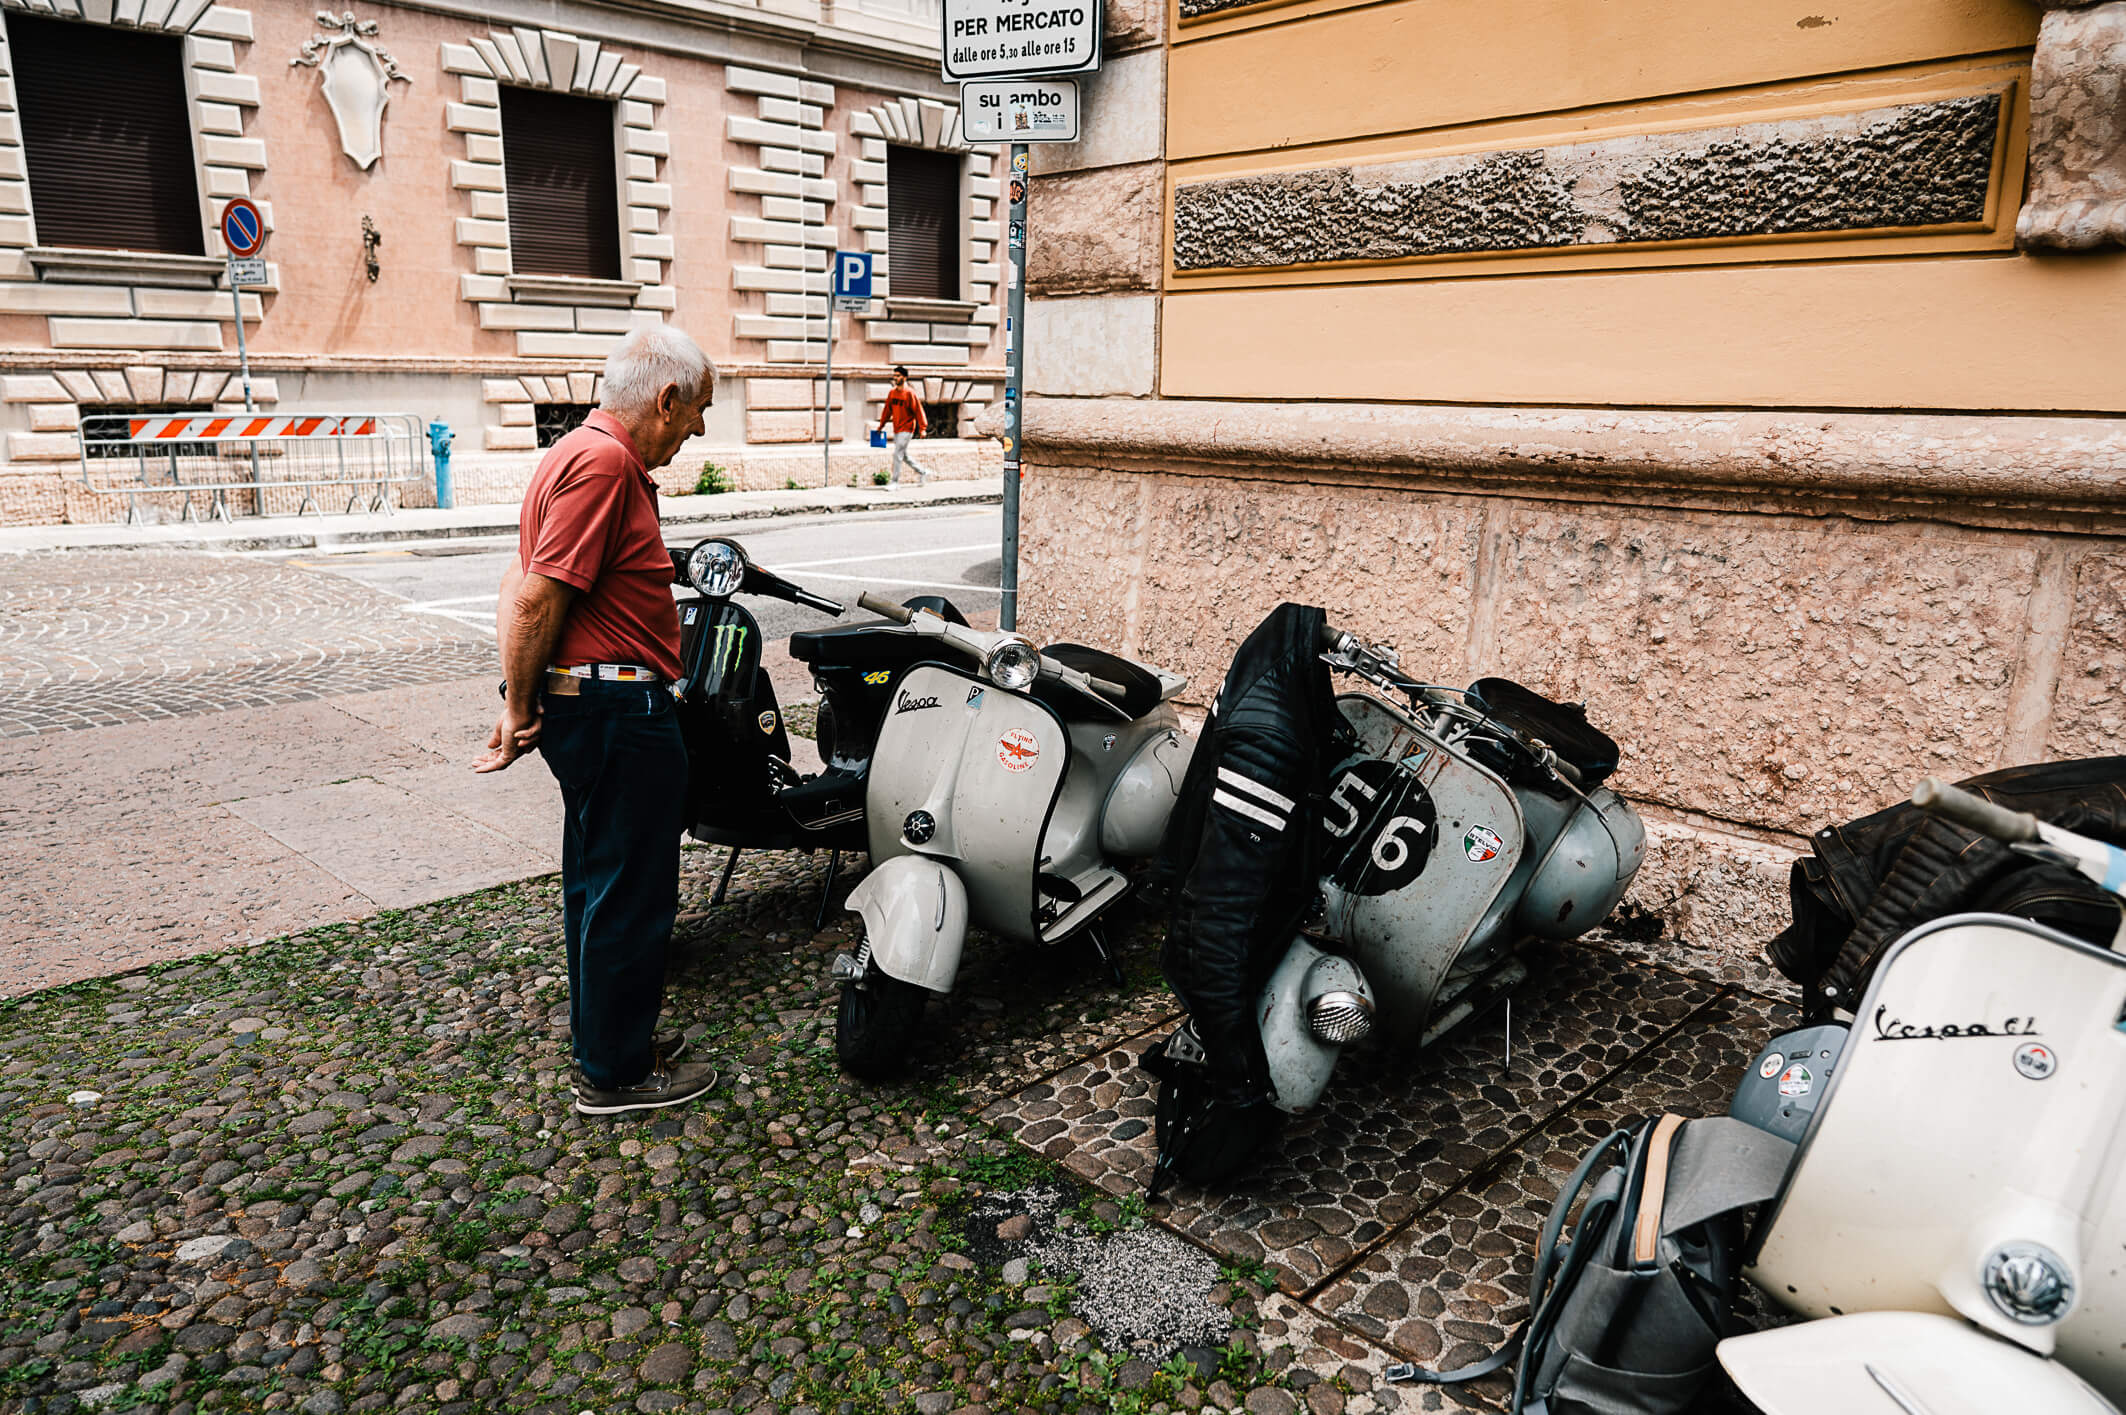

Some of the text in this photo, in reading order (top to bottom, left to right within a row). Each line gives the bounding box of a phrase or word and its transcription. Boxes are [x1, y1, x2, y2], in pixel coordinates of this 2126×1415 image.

[954, 8, 1084, 37] PER MERCATO
[953, 46, 978, 63] dalle
[980, 49, 997, 60] ore
[1021, 40, 1041, 57] alle
[1044, 44, 1061, 54] ore
[1063, 37, 1076, 53] 15
[979, 89, 1062, 108] su ambo
[842, 256, 865, 292] P
[863, 670, 891, 685] 46
[894, 688, 943, 716] Vespa
